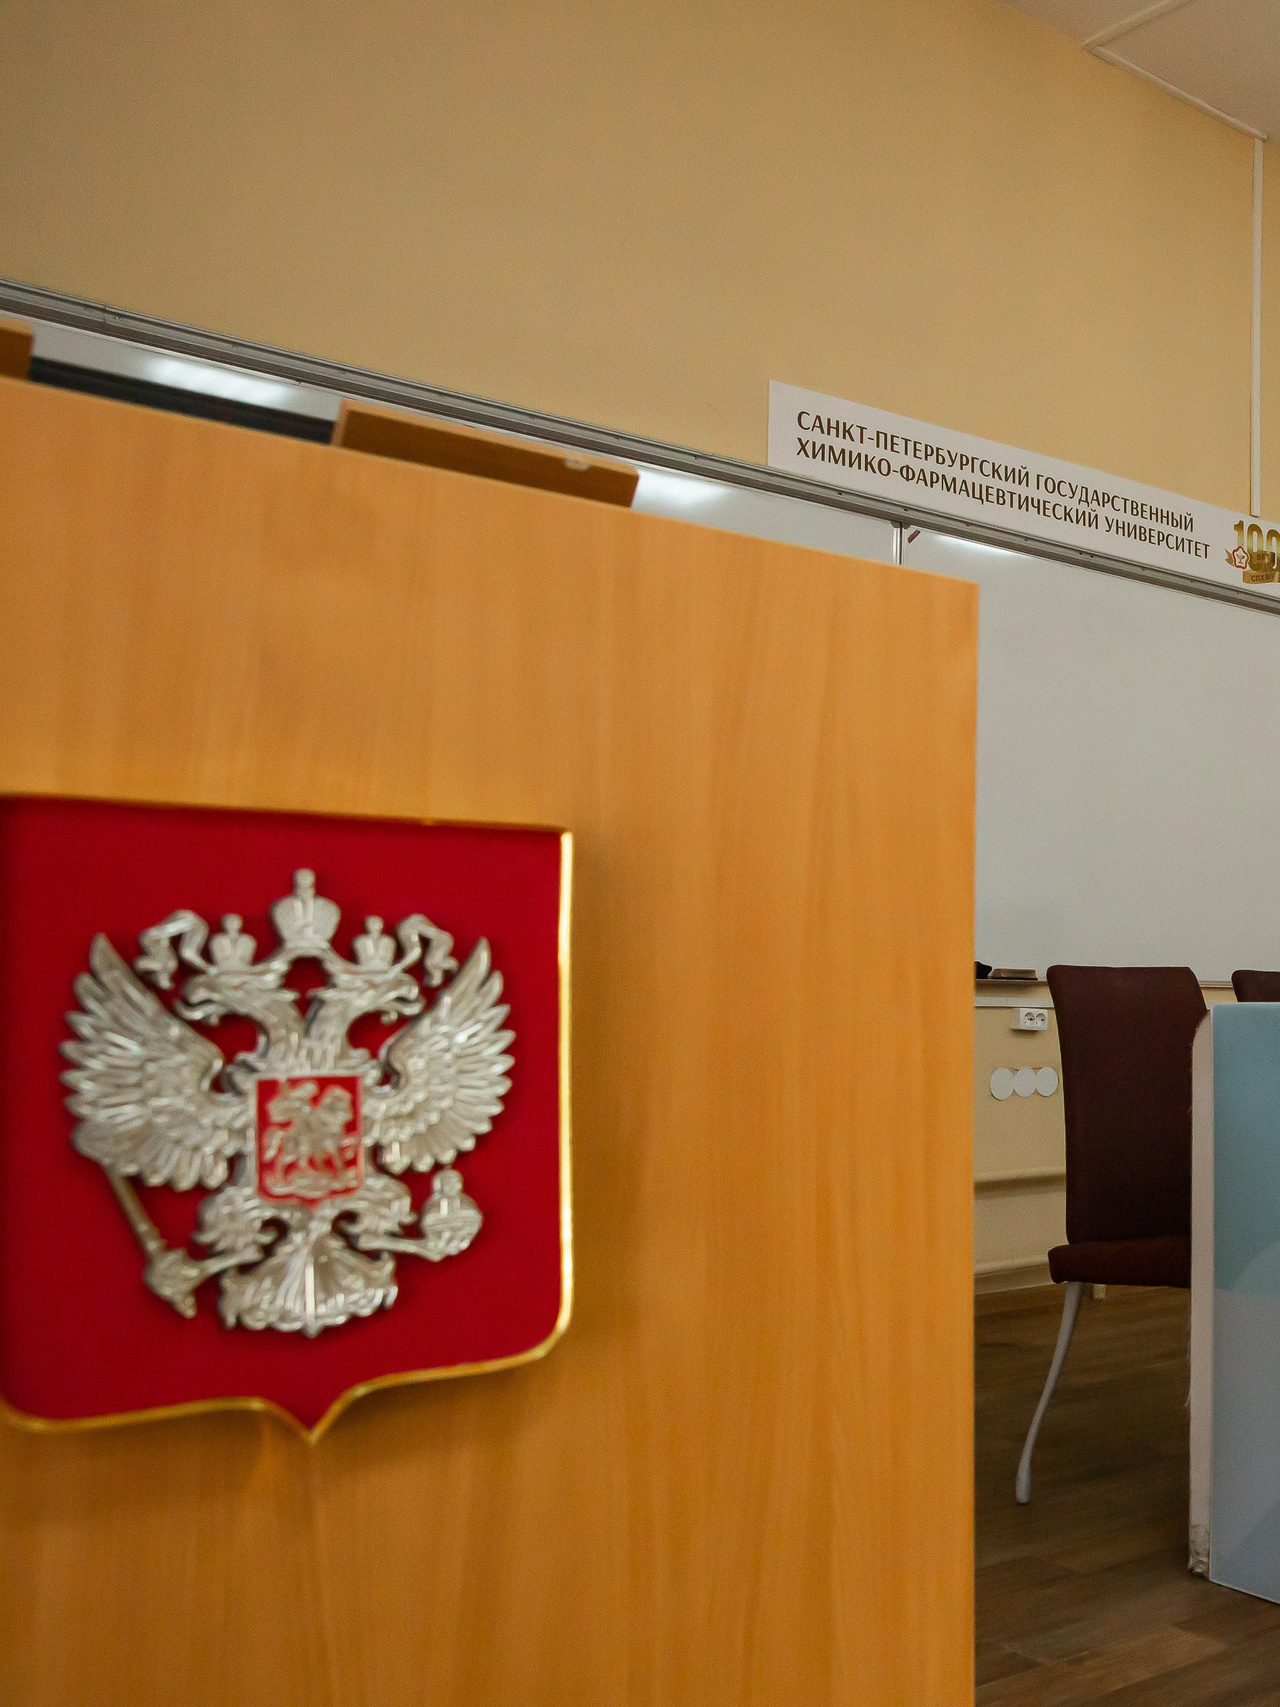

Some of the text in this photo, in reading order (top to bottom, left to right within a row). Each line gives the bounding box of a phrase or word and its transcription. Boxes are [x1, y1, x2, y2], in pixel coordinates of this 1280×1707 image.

[796, 410, 1195, 534] САНКТ-ПЕТЕРБУРГСКИЙ ГОСУДАРСТВЕННЫЙ
[796, 436, 1211, 560] ХИМИКО-ФАРМАЦЕВТИЧЕСКИЙ УНИВЕРСИТЕТ
